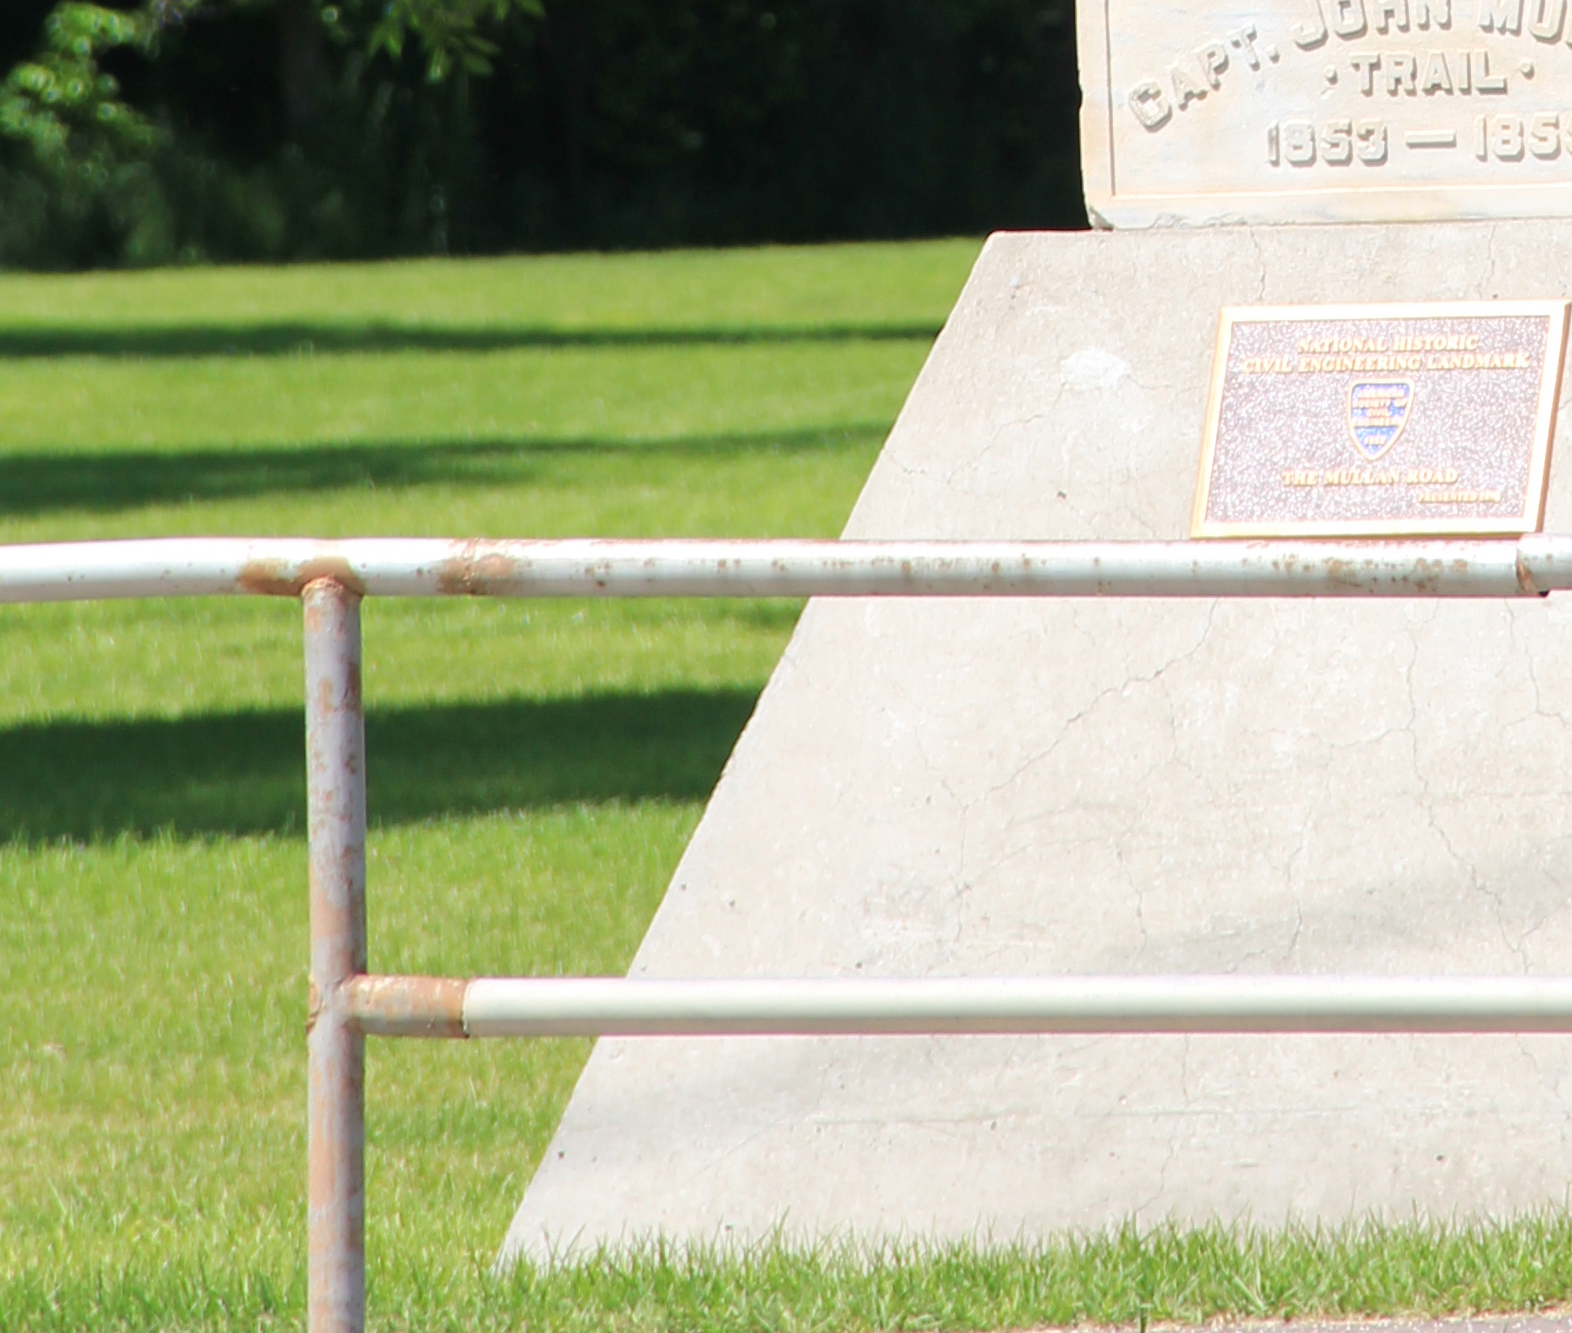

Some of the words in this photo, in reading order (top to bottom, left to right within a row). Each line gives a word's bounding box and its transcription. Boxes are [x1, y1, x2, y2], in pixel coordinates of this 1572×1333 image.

[1127, 21, 1280, 132] CAPT.
[1265, 118, 1389, 167] 1853
[1298, 336, 1388, 353] NATIONAL
[1393, 334, 1479, 351] HISTORIC
[1241, 356, 1292, 373] CIVIL
[1299, 353, 1421, 372] ENGINEERING
[1427, 351, 1529, 370] LANDMARK
[1283, 471, 1317, 486] THE
[1324, 469, 1401, 486] MULLAN
[1406, 468, 1458, 484] ROAD
